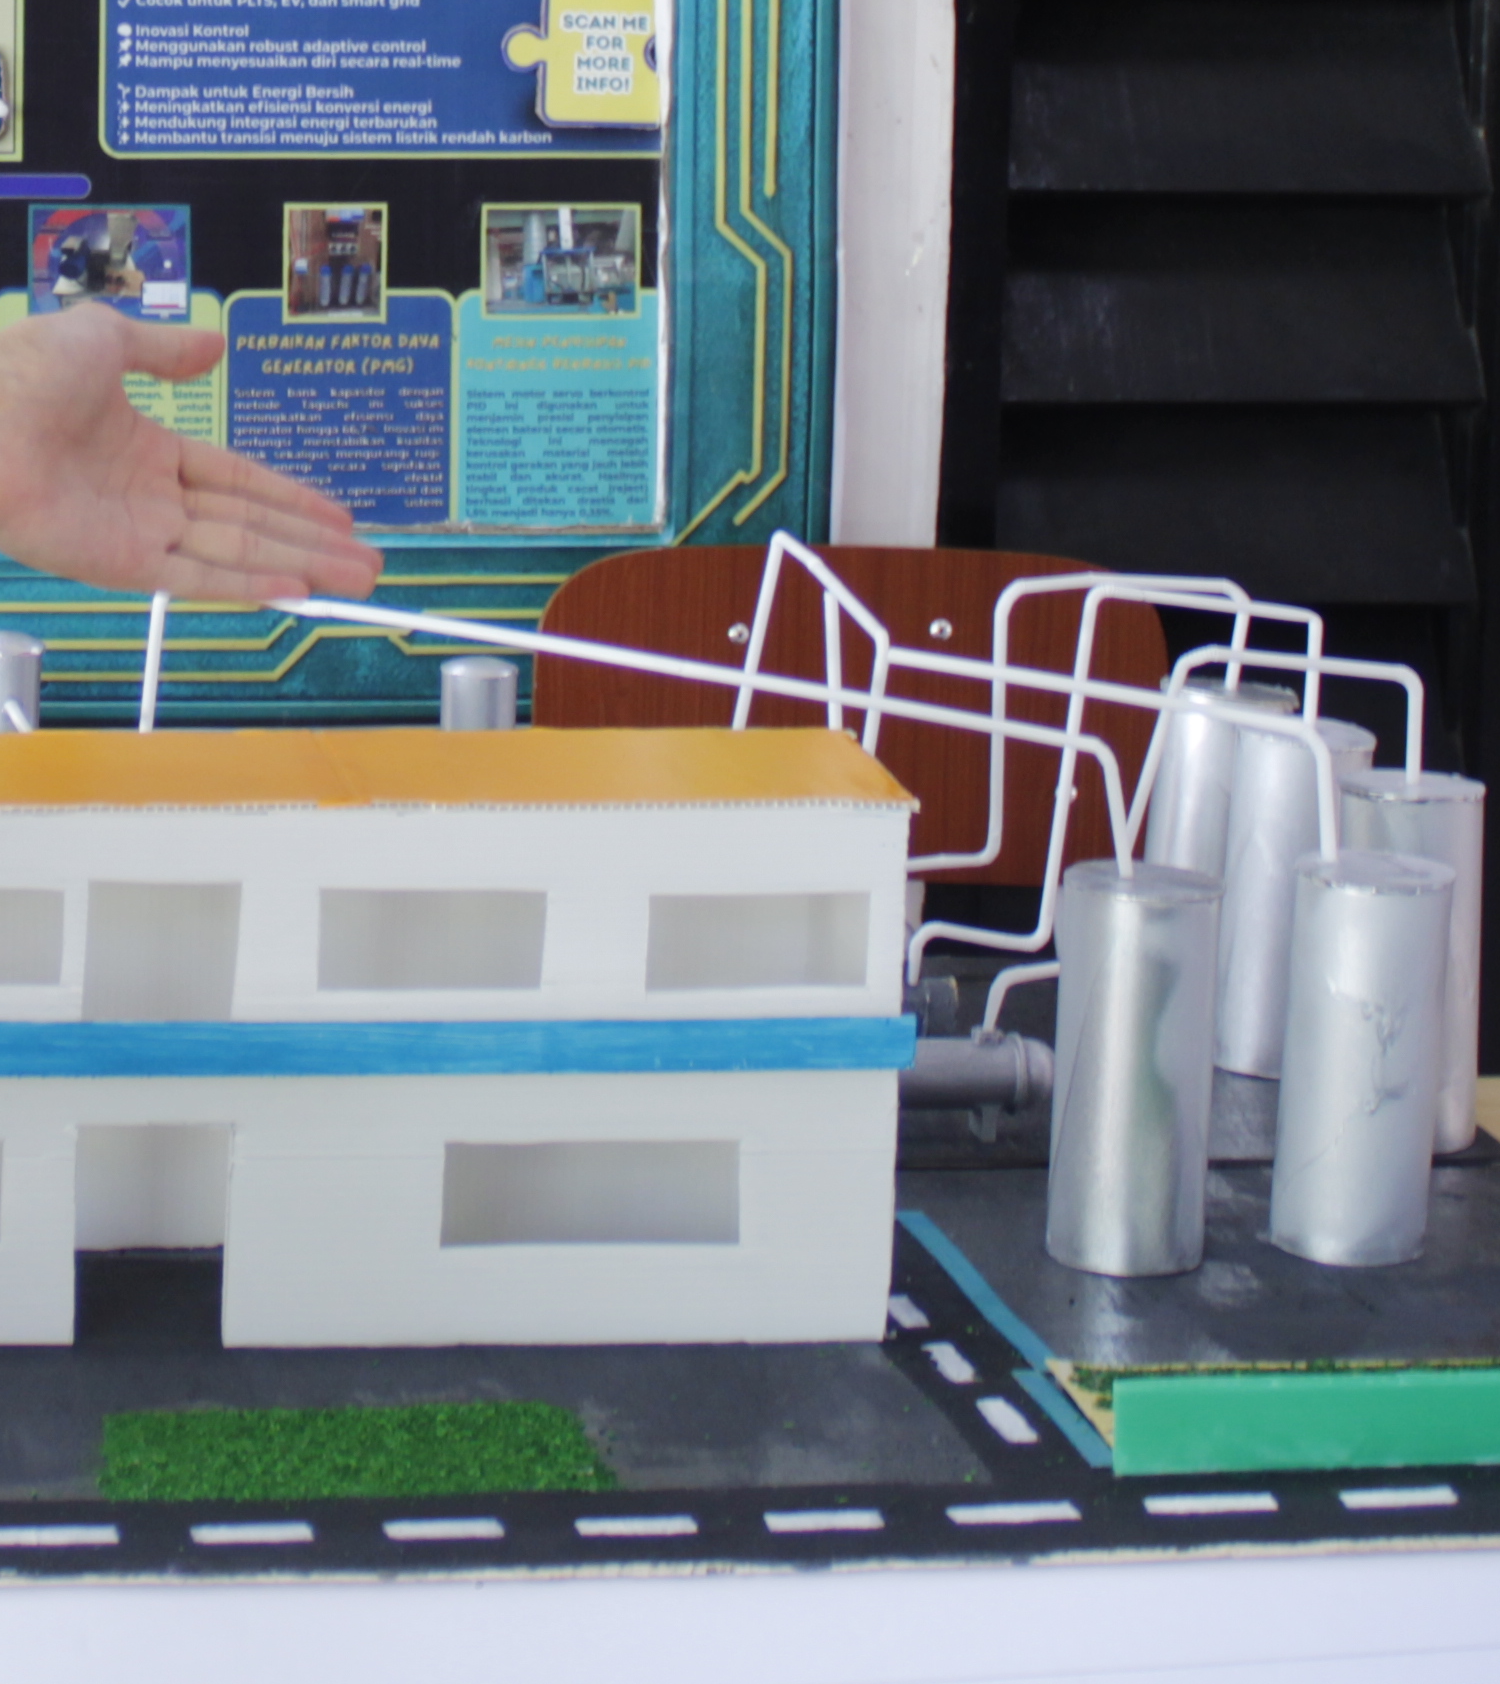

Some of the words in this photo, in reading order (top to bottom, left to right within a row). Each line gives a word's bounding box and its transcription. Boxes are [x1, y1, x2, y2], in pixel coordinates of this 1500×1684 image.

[136, 23, 188, 37] Inovasi
[192, 23, 249, 37] Kontrol
[562, 15, 615, 31] SCAN
[622, 15, 648, 32] ME
[586, 36, 624, 51] FOR
[577, 56, 631, 72] MORE
[576, 77, 630, 93] INFO!
[236, 334, 324, 350] PERBAIKAN
[330, 334, 391, 350] FAKTOR
[398, 334, 440, 349] DAYA
[261, 358, 354, 375] GENERATOR
[361, 358, 414, 375] (PMG)
